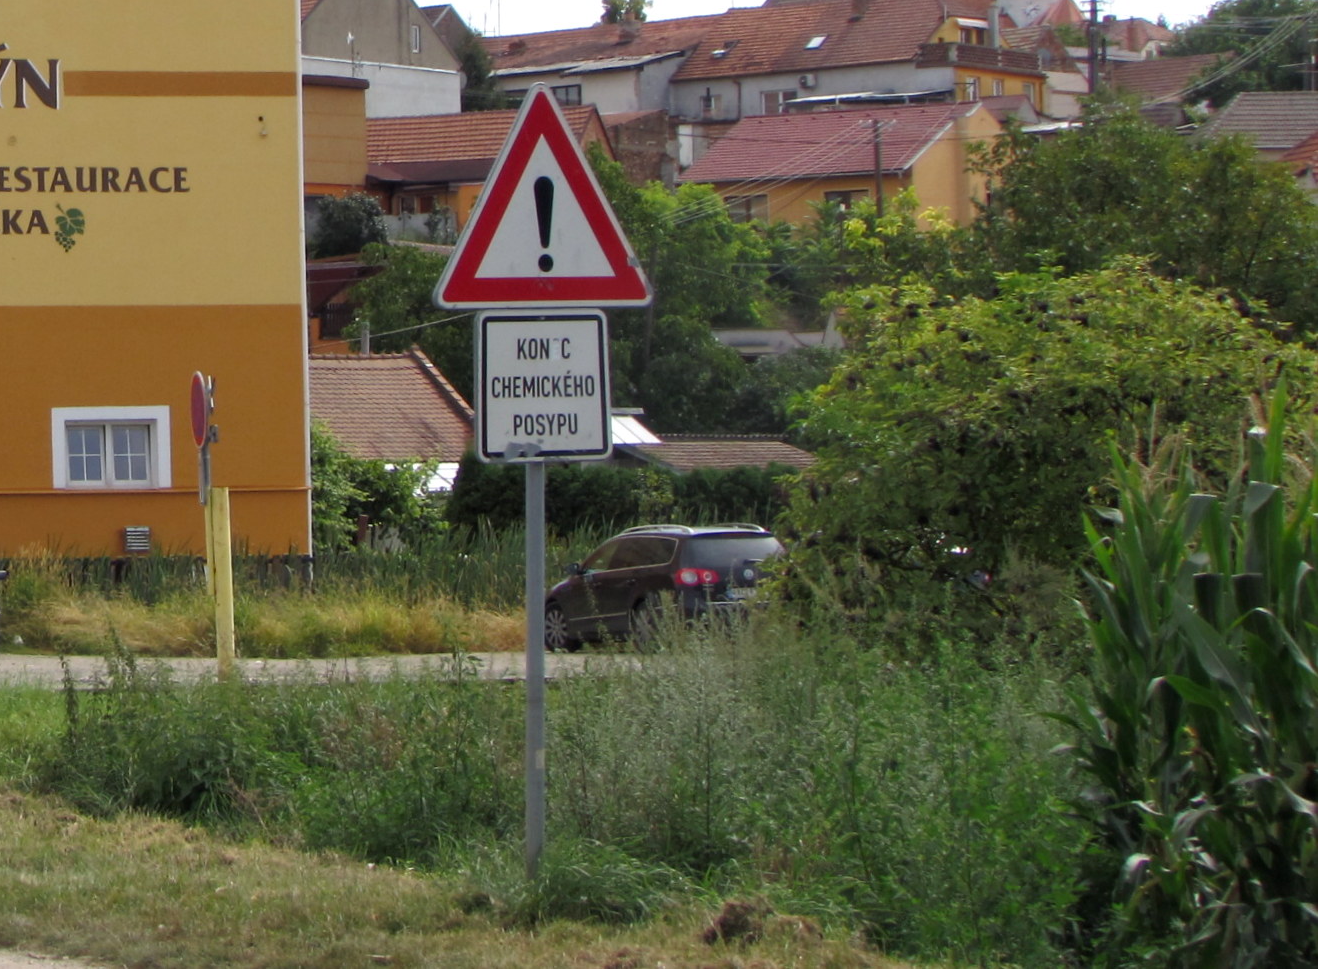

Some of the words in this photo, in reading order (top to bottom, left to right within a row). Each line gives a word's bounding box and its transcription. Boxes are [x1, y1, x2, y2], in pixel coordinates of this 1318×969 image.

[516, 337, 571, 361] KONC
[491, 370, 595, 399] CHEMICKÉHO
[513, 413, 578, 436] POSYPU
